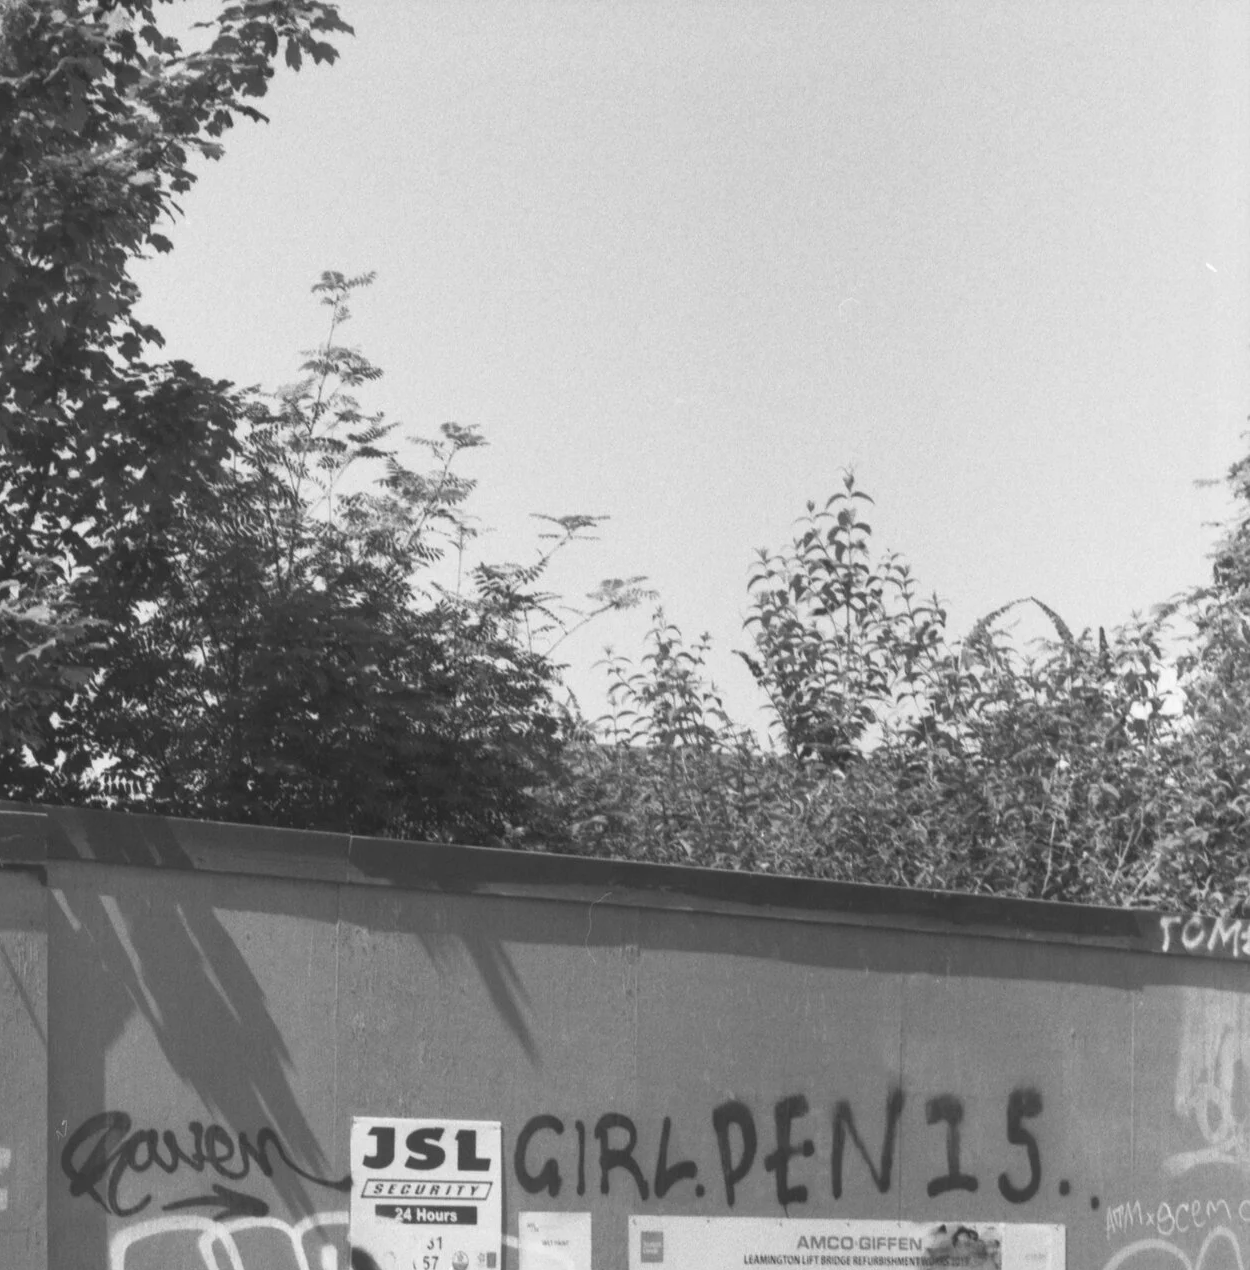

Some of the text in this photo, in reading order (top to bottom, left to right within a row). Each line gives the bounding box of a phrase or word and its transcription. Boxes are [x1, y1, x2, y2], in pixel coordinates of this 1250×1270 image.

[362, 1126, 491, 1172] JSL
[373, 1183, 480, 1197] SECURITY
[395, 1207, 458, 1223] 24 Hours
[743, 1254, 800, 1265] LEAMINGTON
[801, 1254, 819, 1265] LIFT
[820, 1255, 851, 1265] BRIDGE
[852, 1255, 920, 1266] REFURBISHMENT
